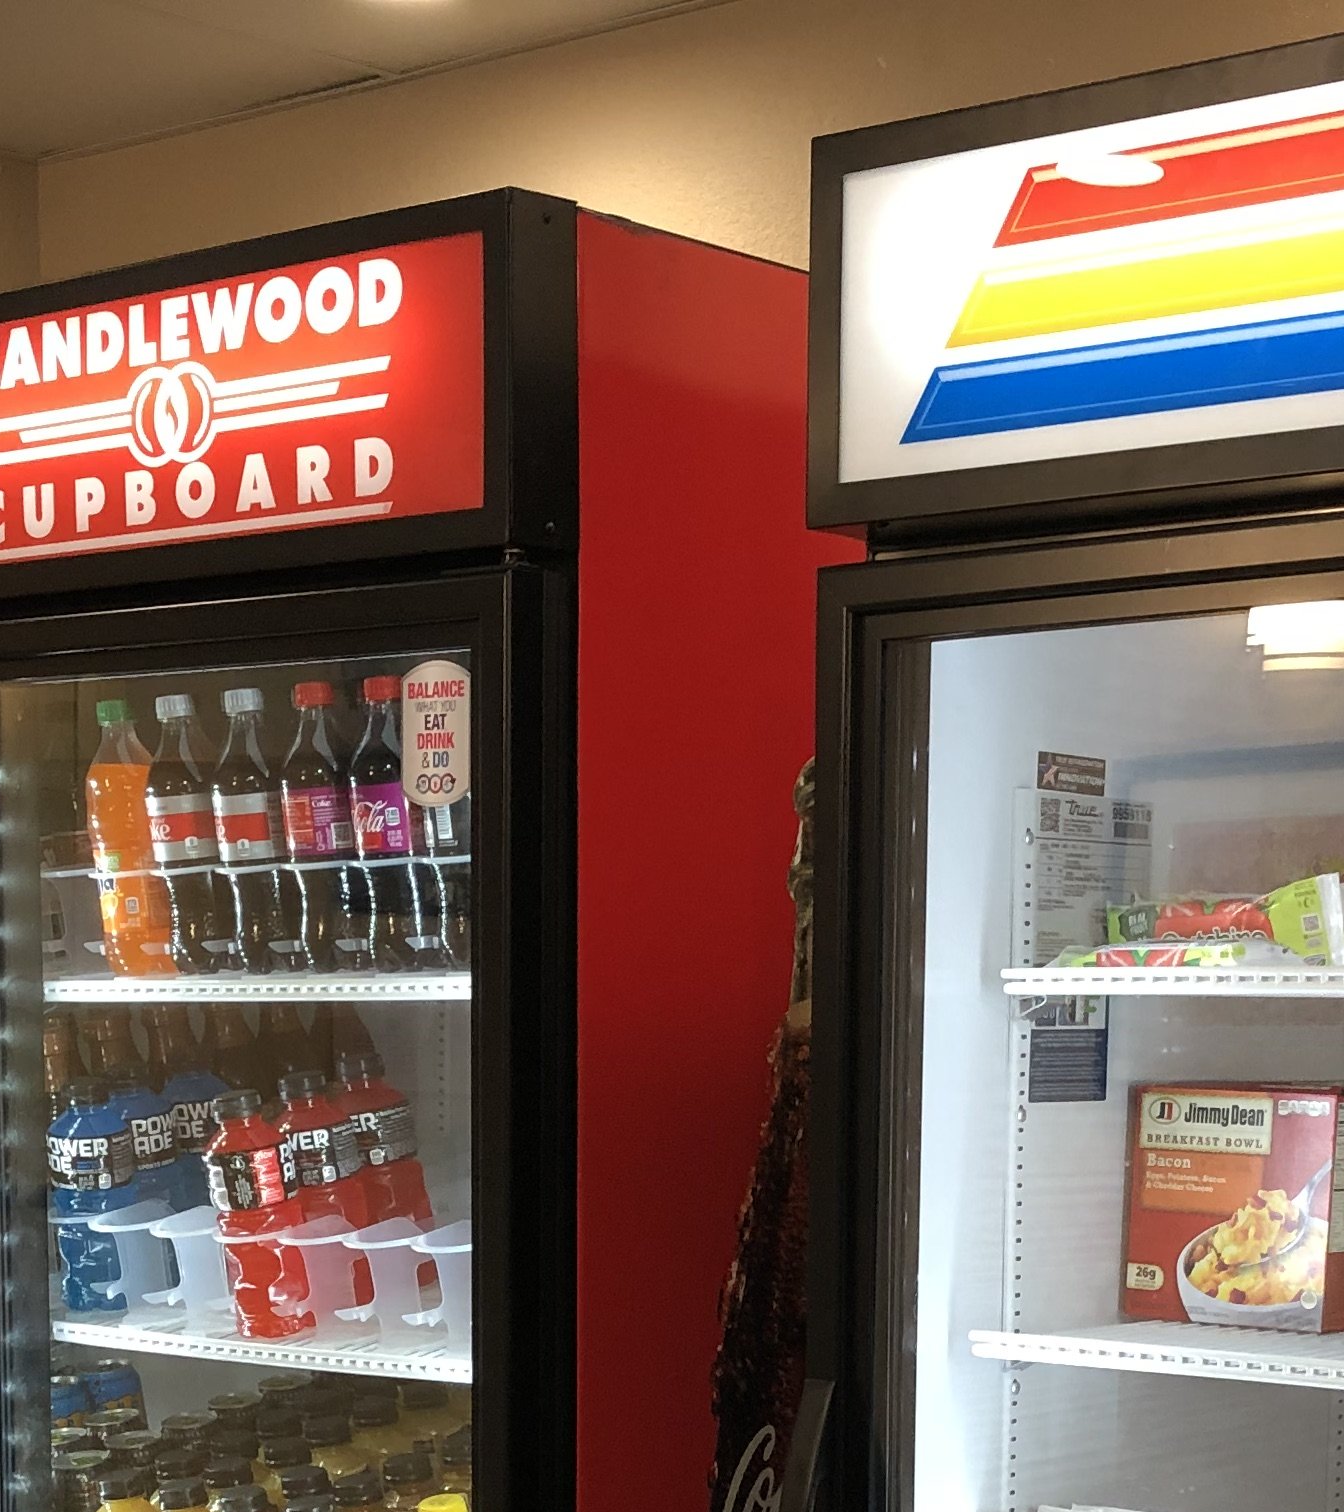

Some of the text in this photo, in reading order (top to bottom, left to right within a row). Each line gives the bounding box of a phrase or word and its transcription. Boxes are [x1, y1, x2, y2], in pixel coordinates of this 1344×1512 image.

[408, 680, 465, 699] BALANCE
[415, 701, 456, 711] WHAT YOU
[424, 714, 447, 730] EAT
[417, 732, 455, 749] DRINK
[432, 751, 449, 767] DO
[1184, 1103, 1229, 1127] Jimmy
[1231, 1105, 1265, 1127] Dean
[47, 1136, 109, 1159] OWER
[1147, 1133, 1263, 1149] BREAKFAST BOWL
[1147, 1153, 1191, 1169] Bacon
[1136, 1265, 1156, 1280] 26g
